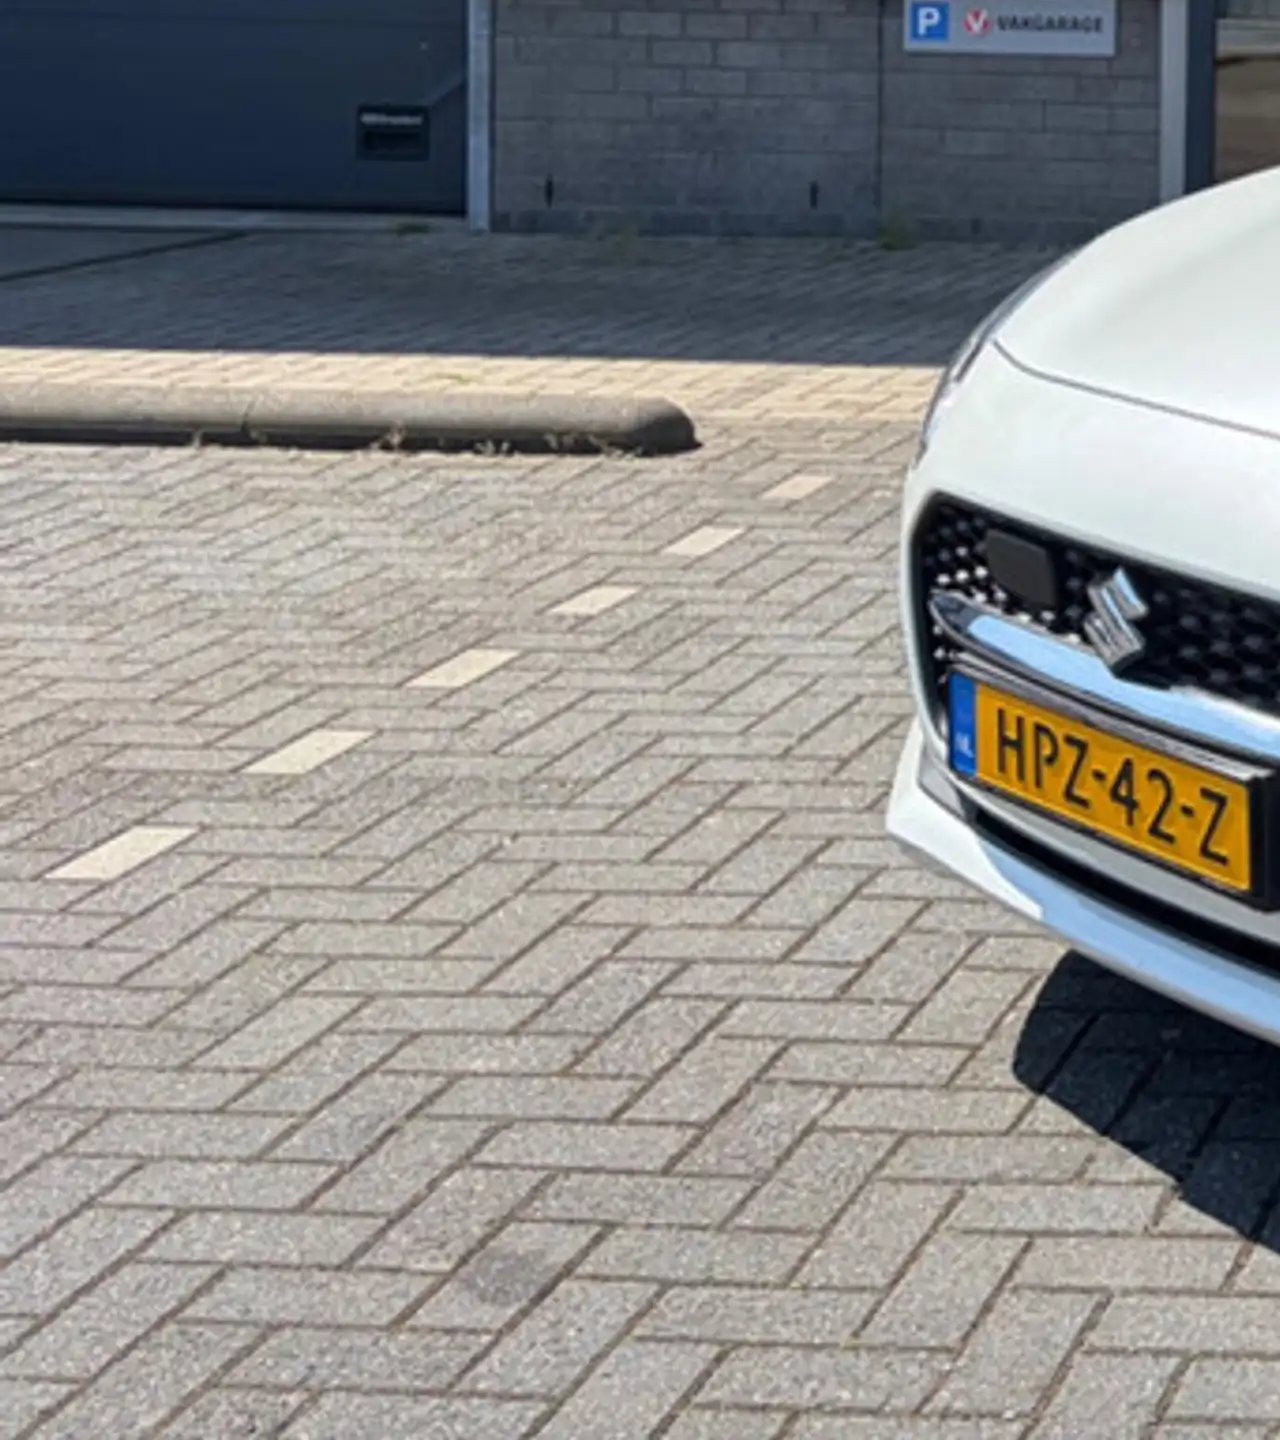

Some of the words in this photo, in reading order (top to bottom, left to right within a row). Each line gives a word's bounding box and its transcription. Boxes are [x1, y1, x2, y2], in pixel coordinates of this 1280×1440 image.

[918, 7, 940, 35] P
[998, 14, 1104, 33] VAKGARAGE
[997, 708, 1229, 866] HPZ-42-Z
